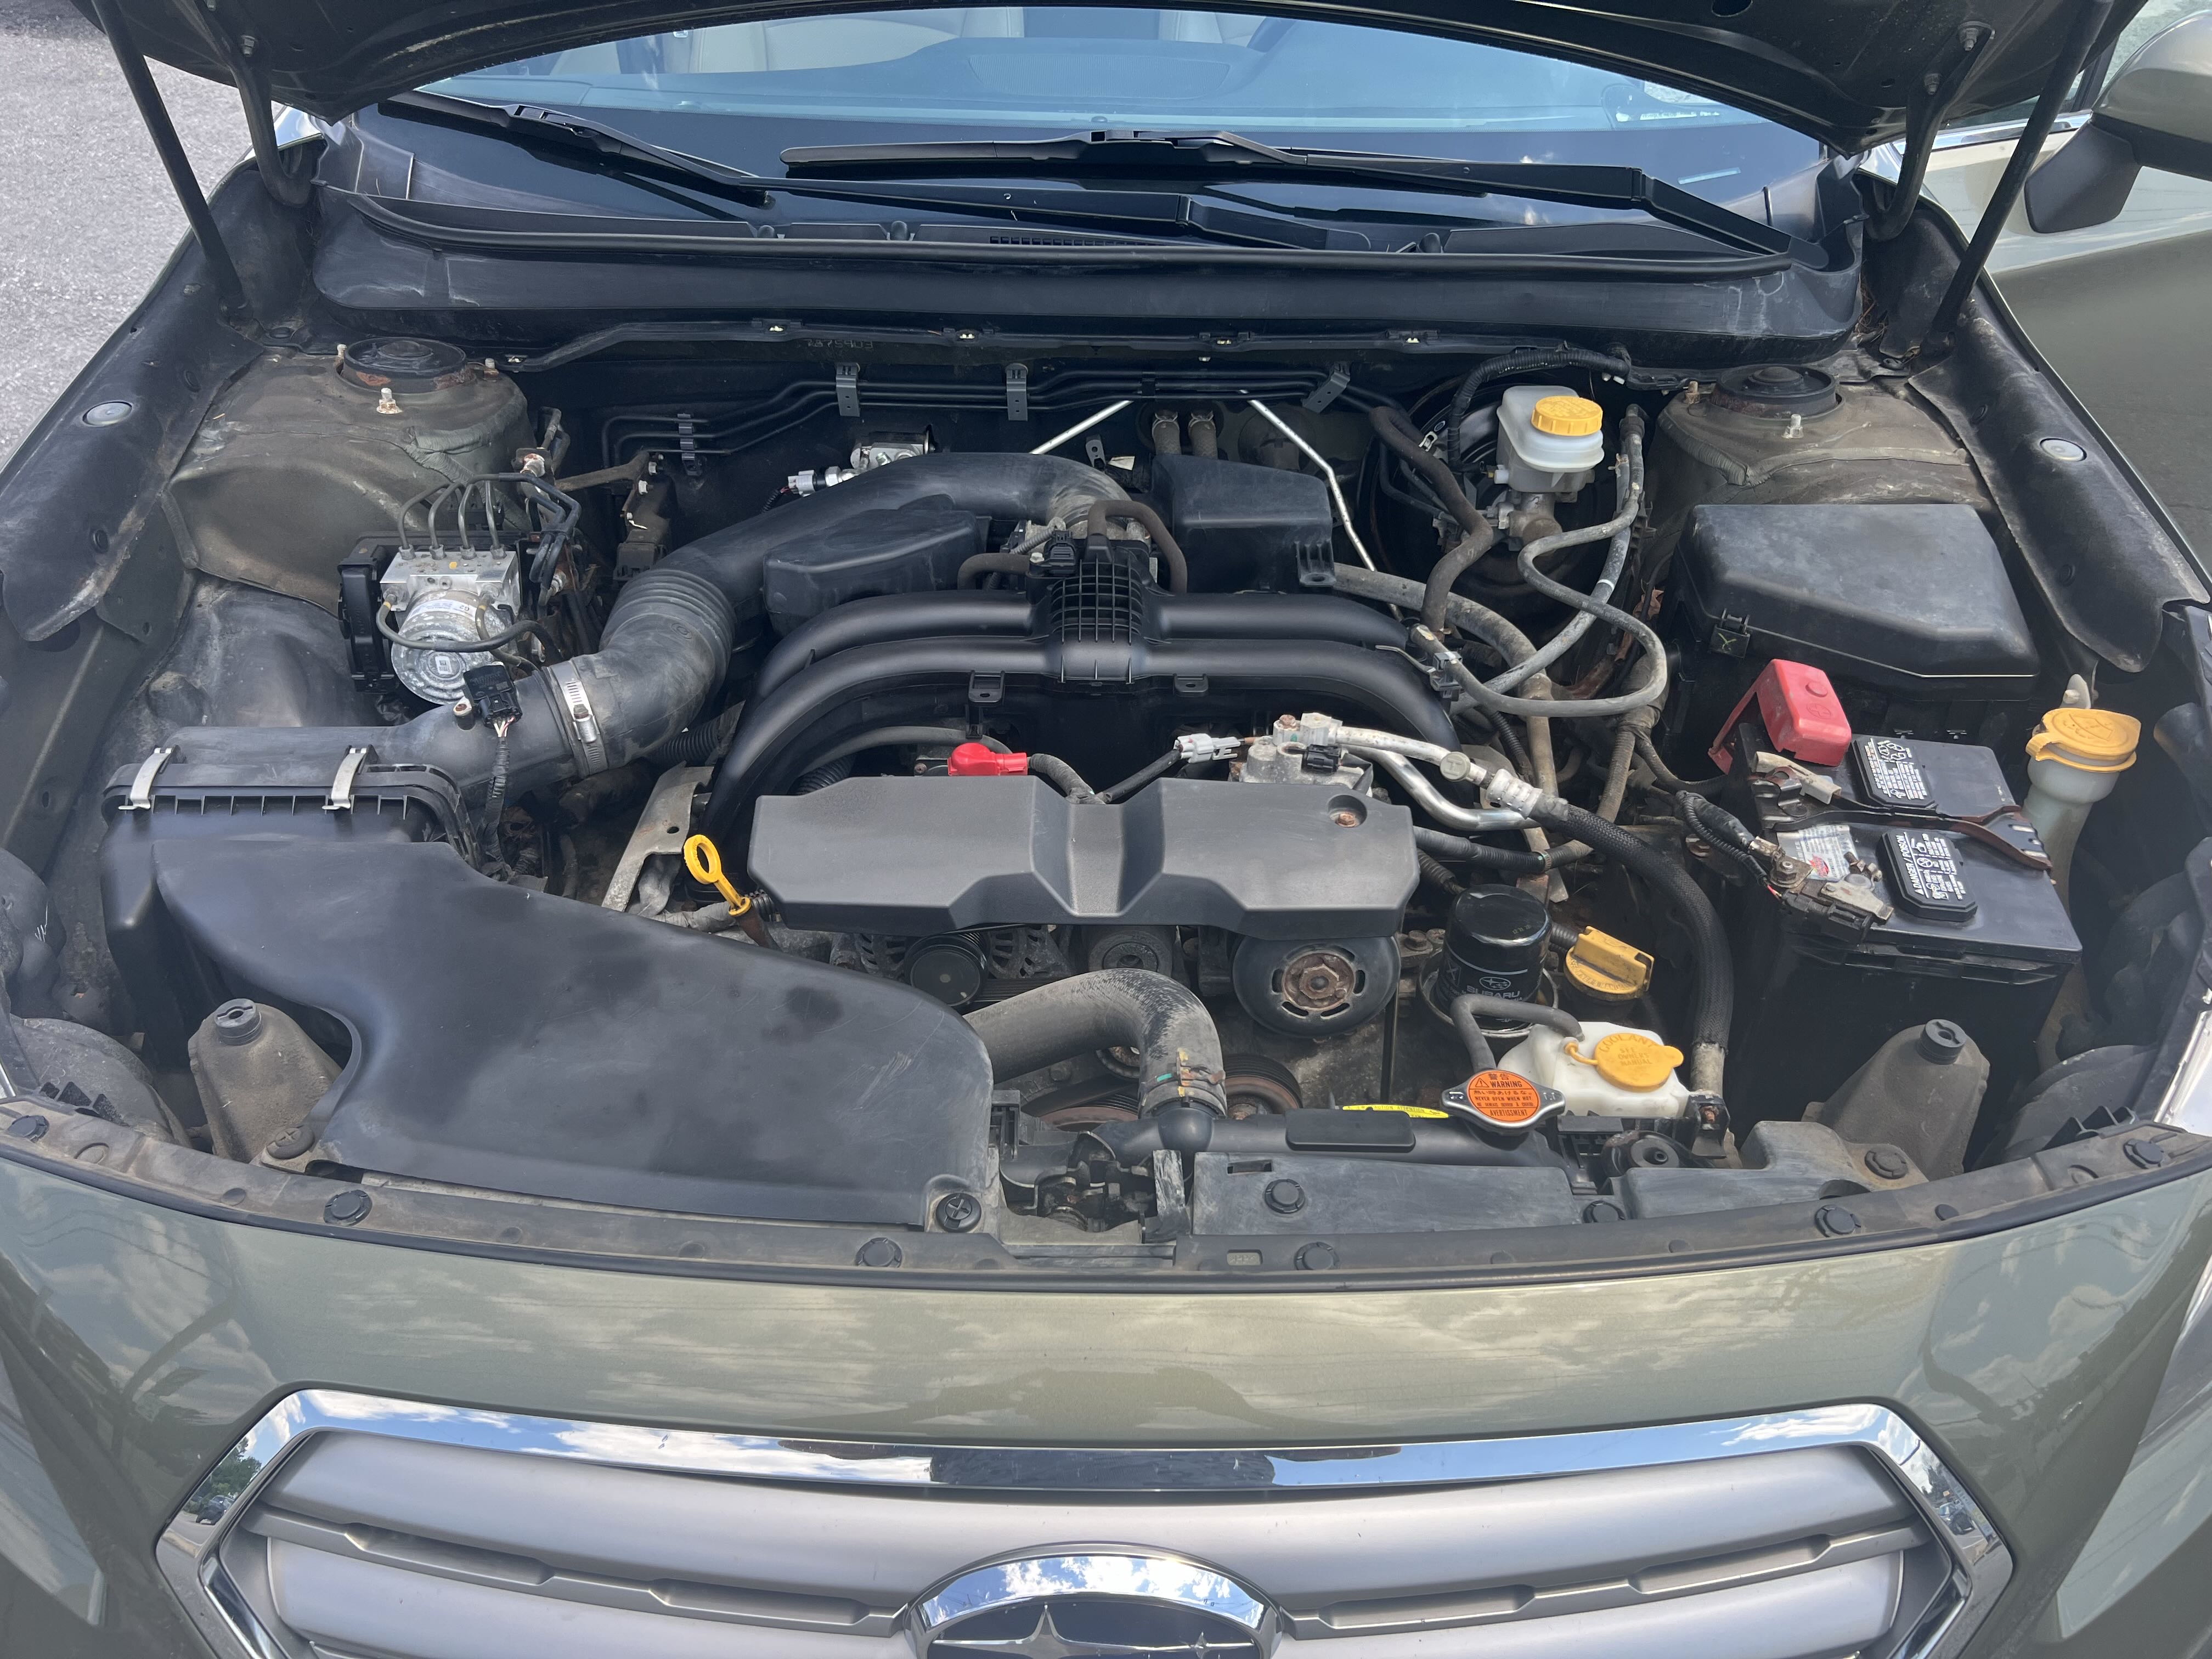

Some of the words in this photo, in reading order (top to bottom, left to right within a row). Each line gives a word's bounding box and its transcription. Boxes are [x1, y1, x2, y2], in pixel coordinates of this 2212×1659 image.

[1896, 835, 1911, 857] POISON
[1905, 863, 1922, 888] DANGER
[1466, 985, 1520, 998] SUBARU
[1599, 1035, 1658, 1052] COOLANT
